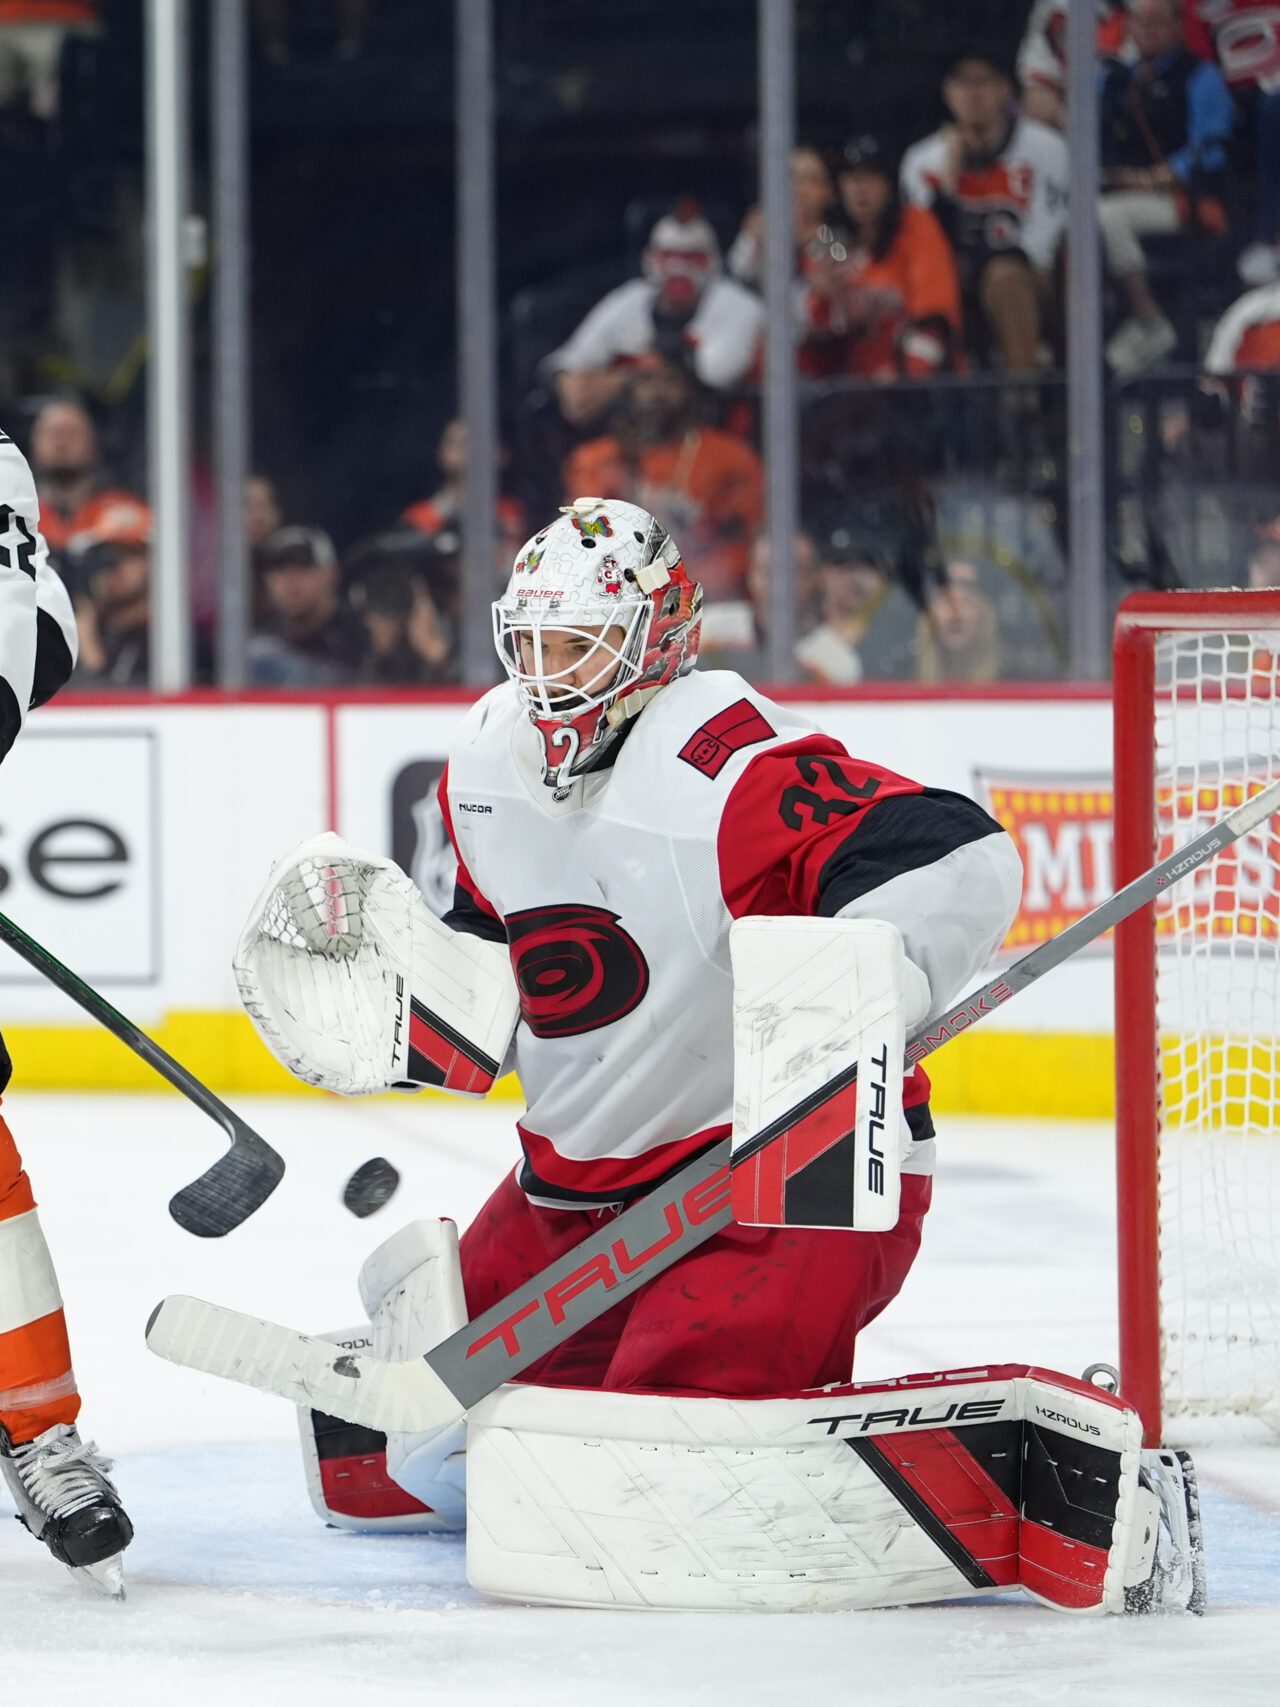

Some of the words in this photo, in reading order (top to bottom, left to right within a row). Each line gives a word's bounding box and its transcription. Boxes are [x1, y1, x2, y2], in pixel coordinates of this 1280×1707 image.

[516, 588, 564, 599] BAUER
[459, 803, 493, 814] NUCOR
[778, 754, 882, 832] 32
[391, 973, 404, 1068] TRUE
[906, 981, 1015, 1064] SMOKE
[868, 1042, 888, 1197] TRUE
[465, 1163, 732, 1360] TRUE
[807, 1399, 1006, 1435] TRUE
[1035, 1405, 1101, 1436] HZRDUS
